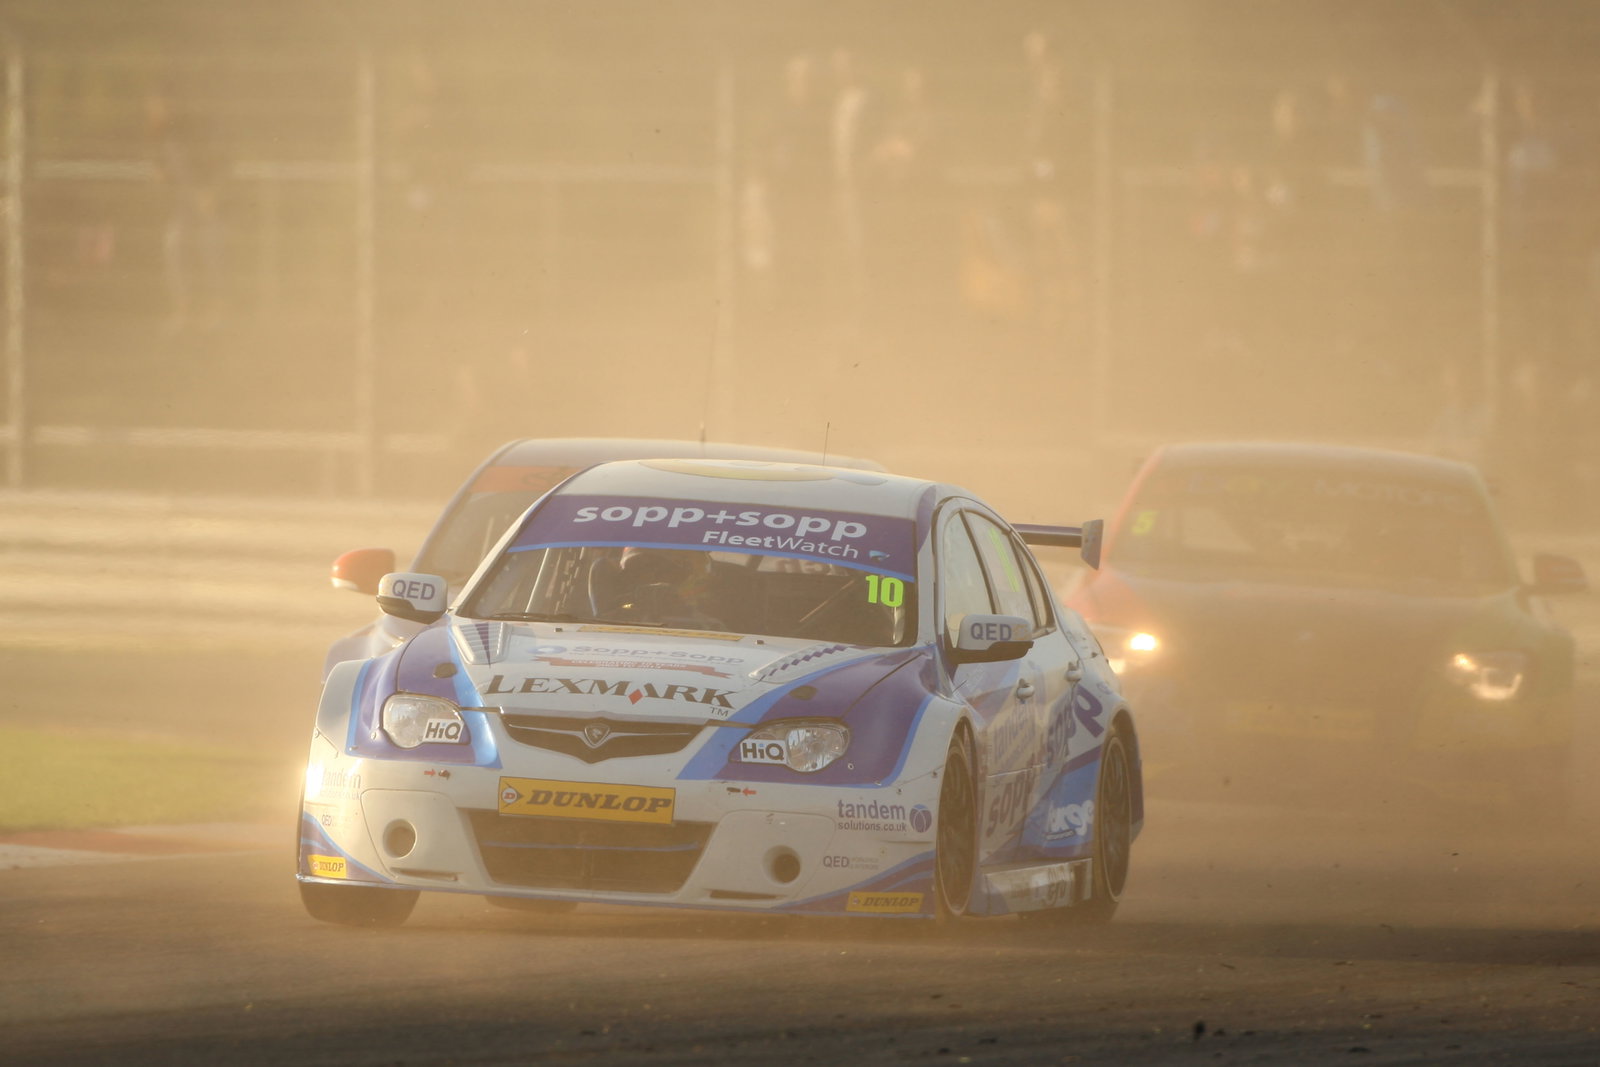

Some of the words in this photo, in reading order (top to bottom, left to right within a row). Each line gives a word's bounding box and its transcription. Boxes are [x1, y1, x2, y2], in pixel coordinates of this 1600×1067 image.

[573, 505, 867, 541] sopp+sopp
[702, 531, 859, 559] FleetWatch
[391, 579, 436, 601] QED
[865, 575, 904, 607] 10
[970, 622, 1012, 641] QED
[484, 675, 739, 710] LEXMARK
[709, 706, 729, 717] TM
[425, 720, 462, 742] HiQ
[742, 742, 785, 761] HiQ
[526, 789, 673, 813] DUNLOP
[837, 799, 906, 820] tandem
[838, 820, 907, 832] solutions.co.uk
[822, 855, 850, 868] QED
[862, 896, 919, 907] DUNLOP
